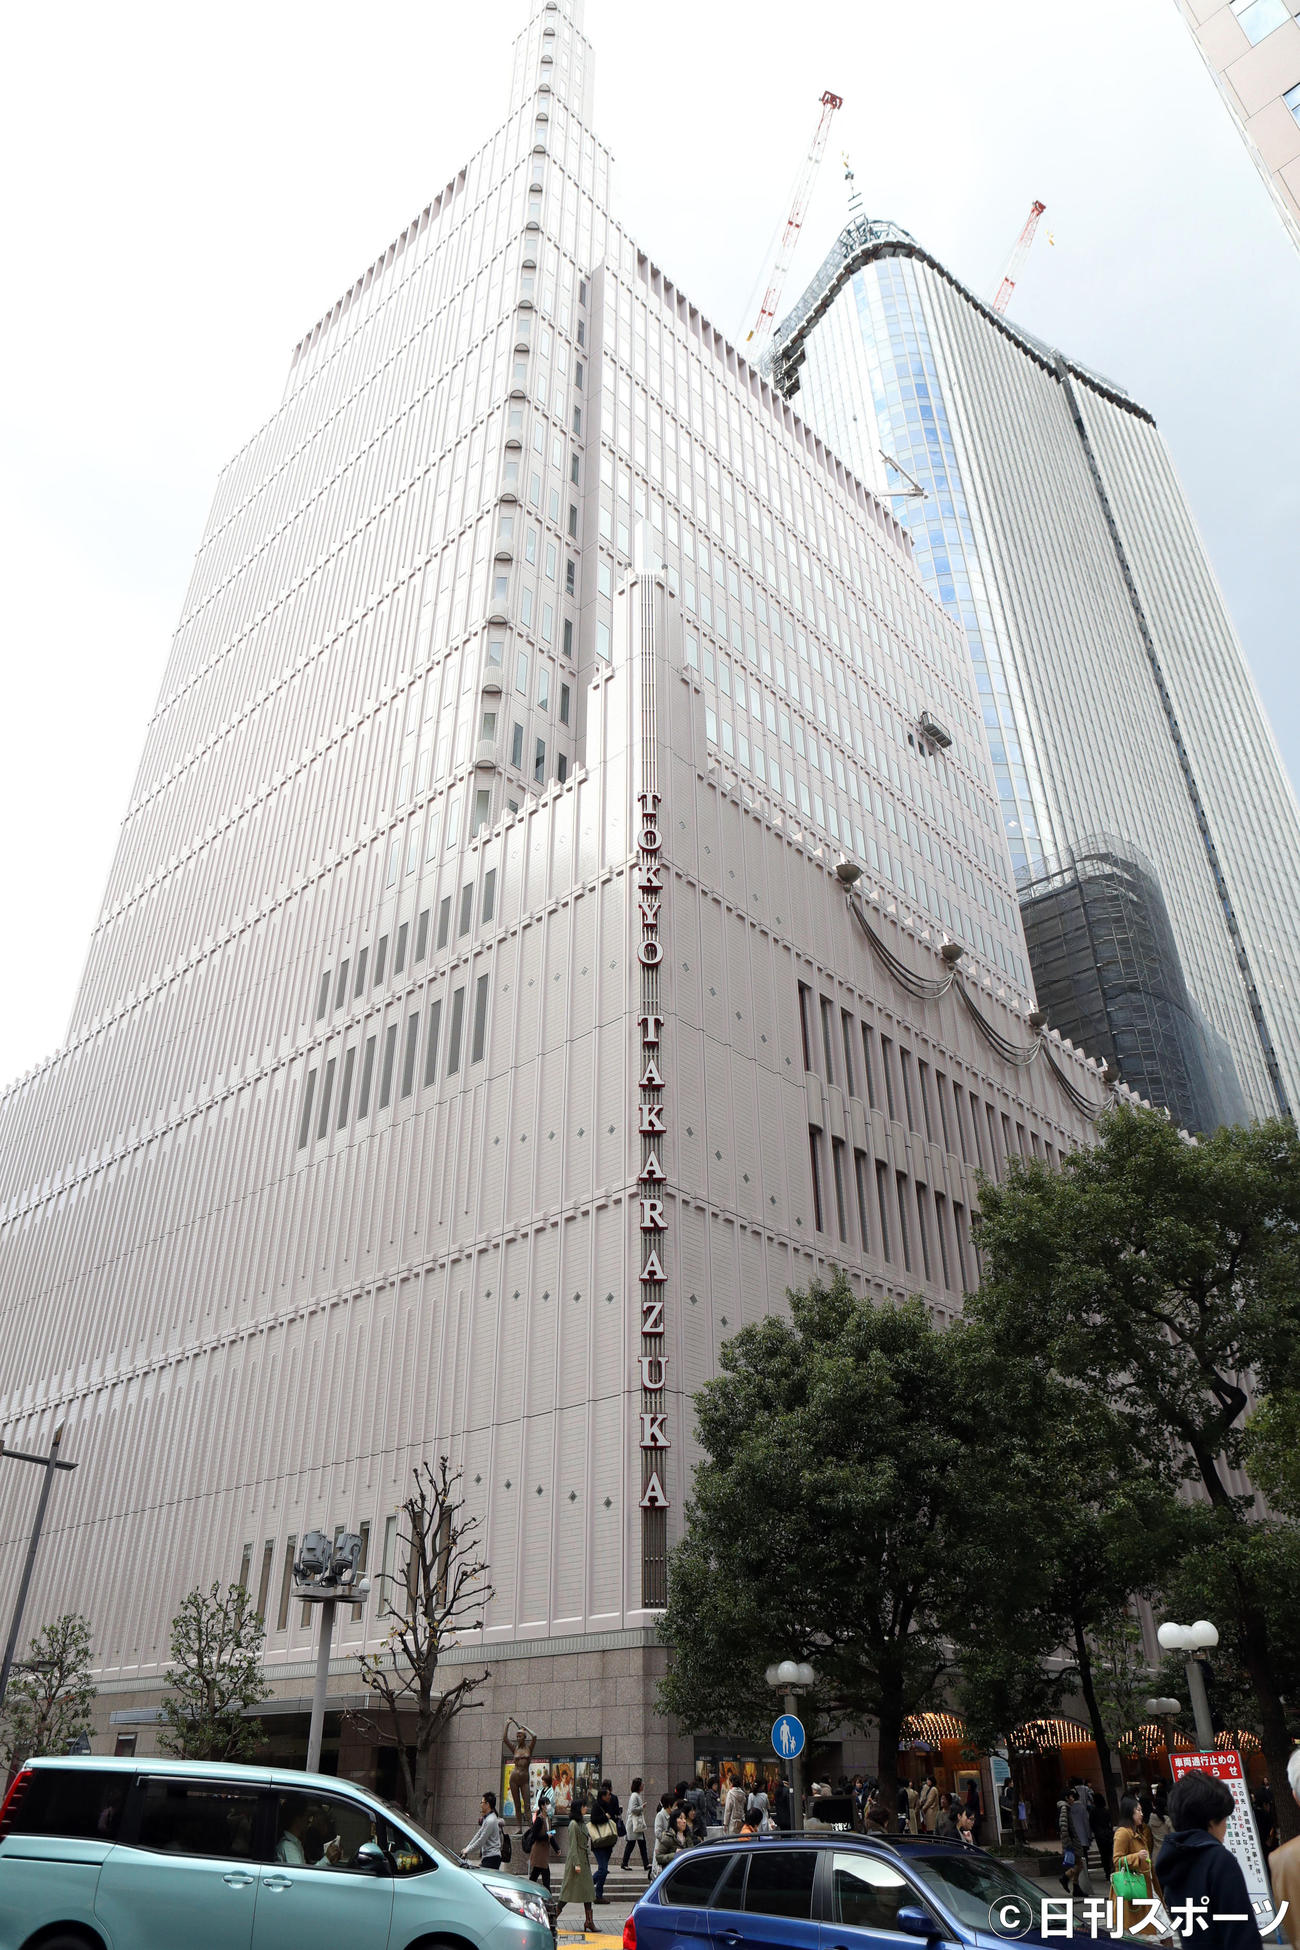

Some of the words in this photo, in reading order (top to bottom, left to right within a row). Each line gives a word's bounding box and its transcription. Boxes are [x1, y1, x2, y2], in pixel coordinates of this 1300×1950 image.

[637, 791, 664, 967] TOKYO
[638, 1014, 671, 1509] TAKARAZUKA
[1174, 1755, 1236, 1767] 車両通行止めの
[1177, 1766, 1238, 1779] おらせ
